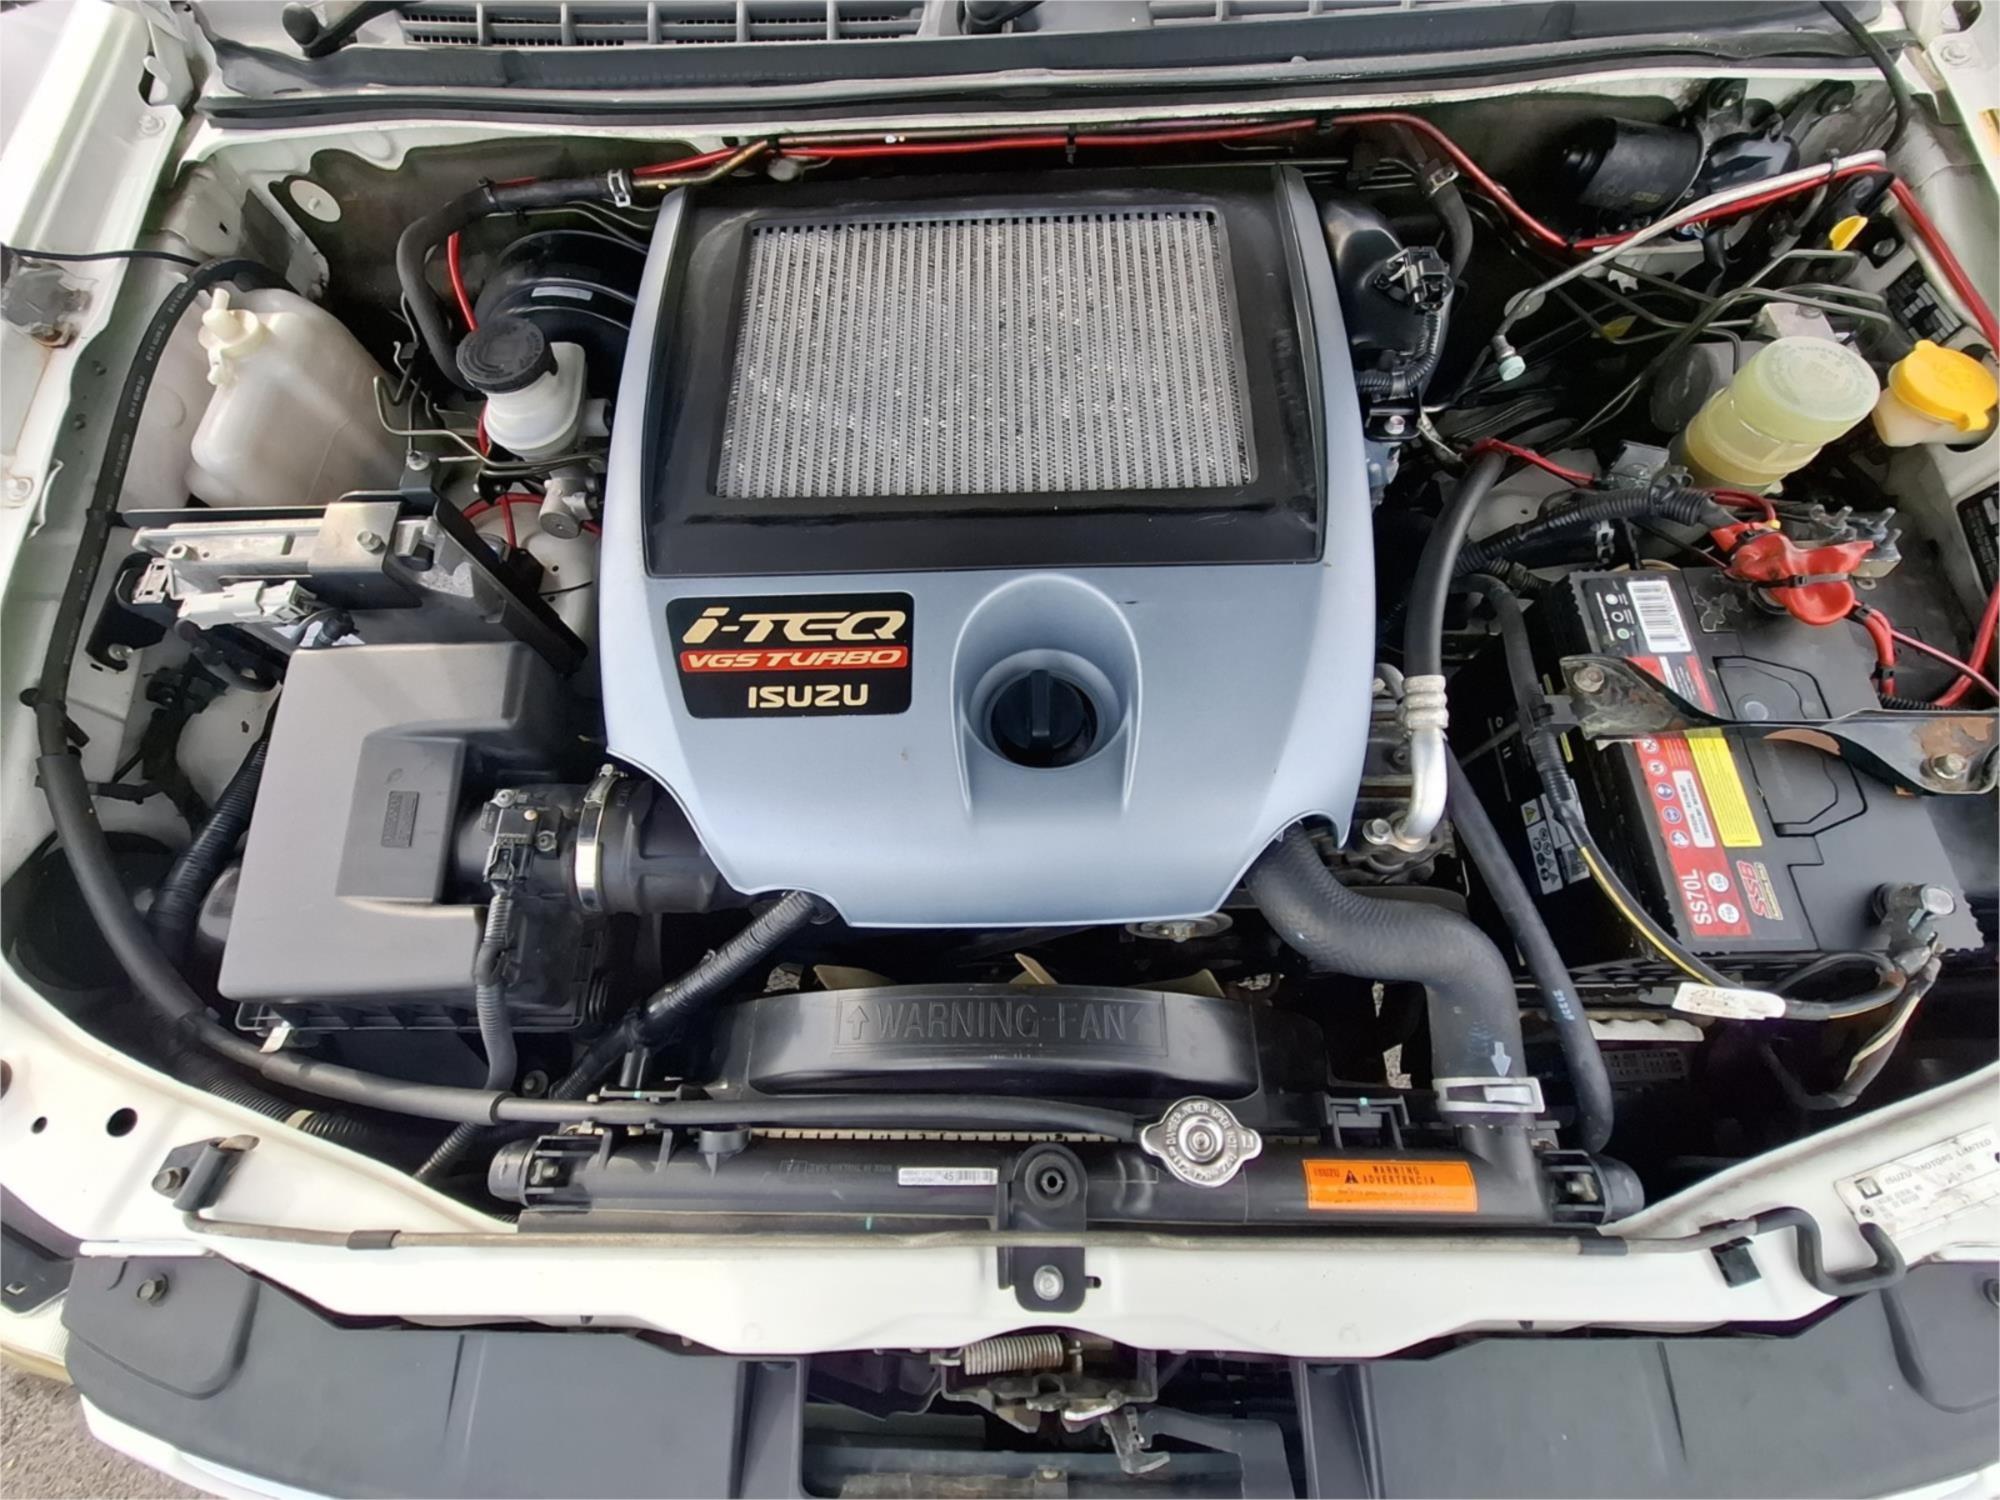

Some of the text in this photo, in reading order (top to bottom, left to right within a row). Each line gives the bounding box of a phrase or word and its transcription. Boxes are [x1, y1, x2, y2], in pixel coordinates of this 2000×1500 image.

[682, 607, 907, 644] i-TEQ
[687, 649, 902, 668] VGS TURBO
[748, 683, 869, 708] ISUZU
[1680, 869, 1713, 925] SS70L
[1735, 860, 1767, 917] SSB
[879, 1001, 1128, 1040] WARNING FAN
[1362, 1175, 1436, 1185] ADVERTENCIA
[1372, 1165, 1420, 1176] WARNING
